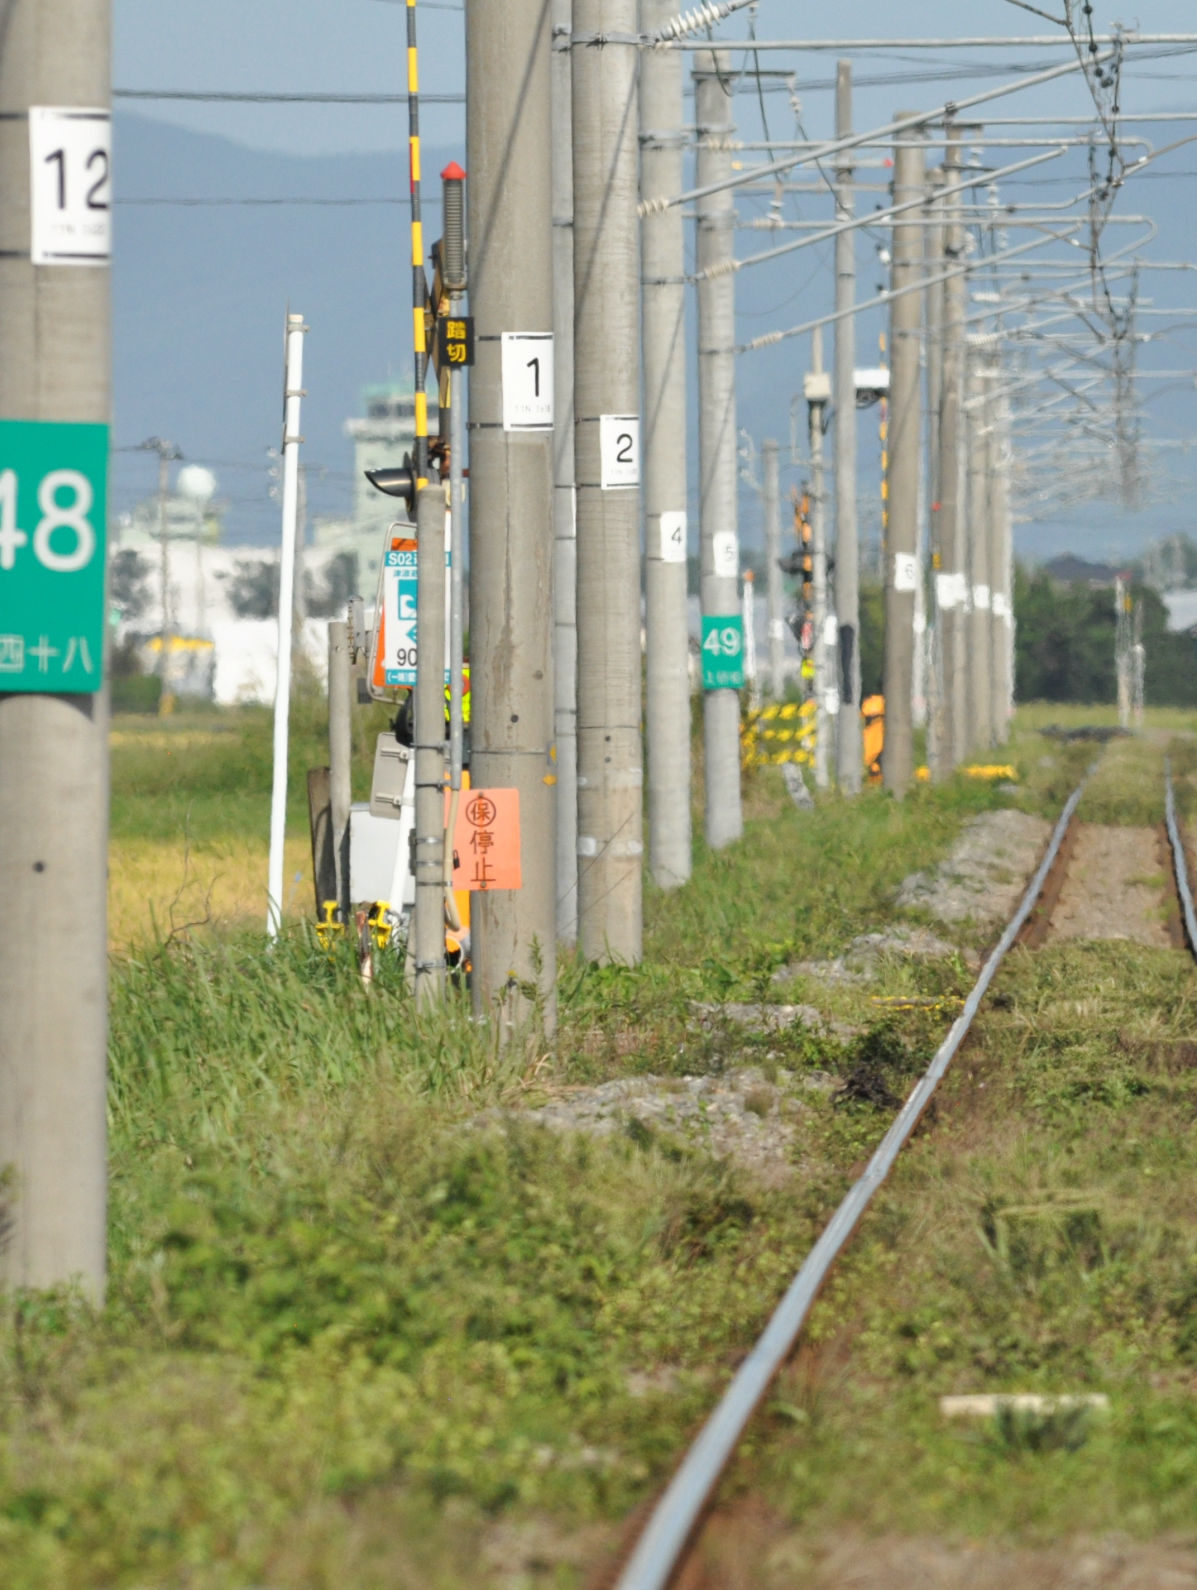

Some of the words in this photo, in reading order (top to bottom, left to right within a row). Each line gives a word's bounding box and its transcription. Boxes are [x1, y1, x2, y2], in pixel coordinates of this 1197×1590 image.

[45, 148, 109, 210] 12
[446, 321, 467, 362] 踏切
[526, 357, 540, 398] 1
[616, 433, 633, 463] 2
[671, 526, 682, 544] 4
[703, 627, 741, 656] 49
